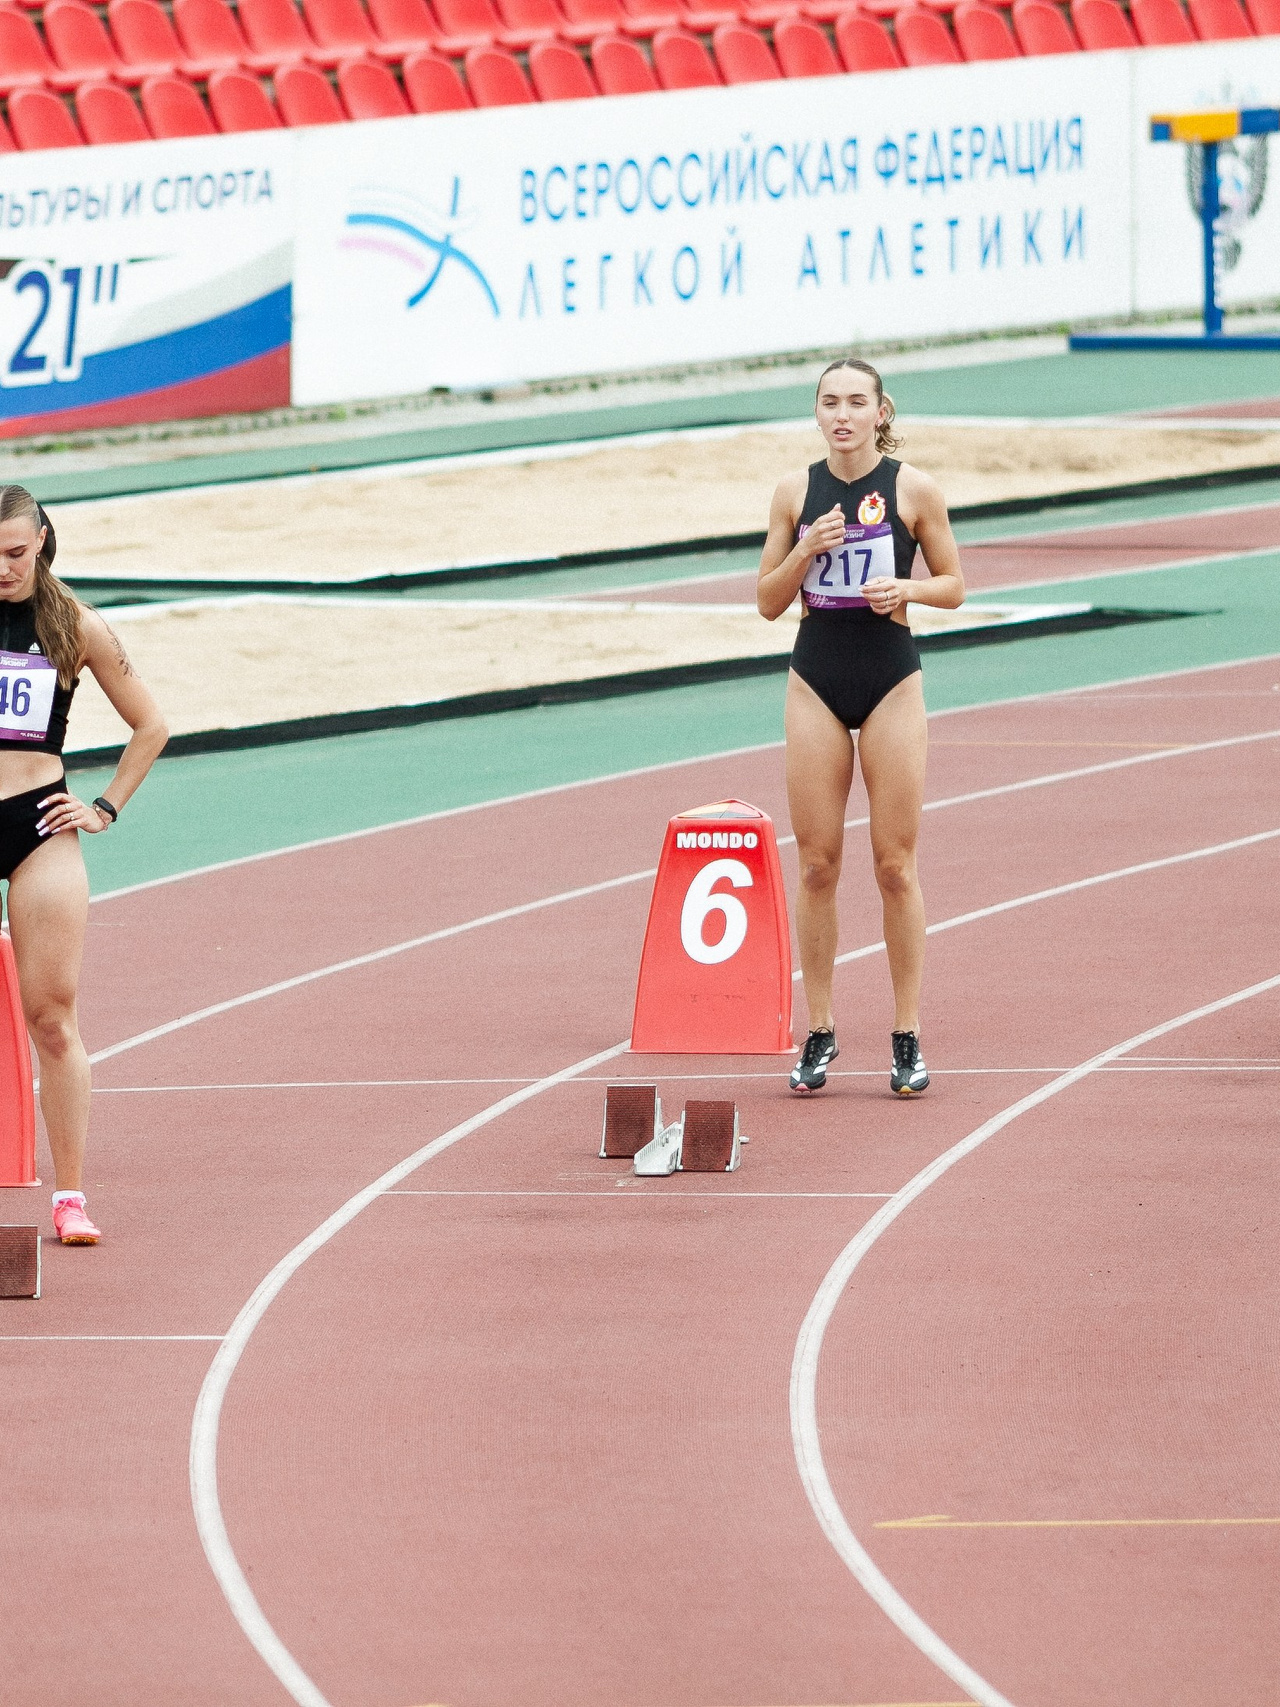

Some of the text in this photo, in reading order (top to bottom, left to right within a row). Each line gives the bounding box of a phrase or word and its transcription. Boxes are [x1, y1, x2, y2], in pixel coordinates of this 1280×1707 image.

[121, 179, 143, 218] И
[152, 169, 273, 214] СПОРТА
[521, 115, 1082, 224] ВСЕРОССИЙСКАЯ ФЕДЕРАЦИЯ
[519, 204, 1084, 321] ЛЕГКОЙ АТЛЕТИКИ
[8, 263, 119, 375] 21"
[815, 549, 872, 586] 217
[676, 832, 758, 849] MONDO
[680, 858, 754, 965] 6
